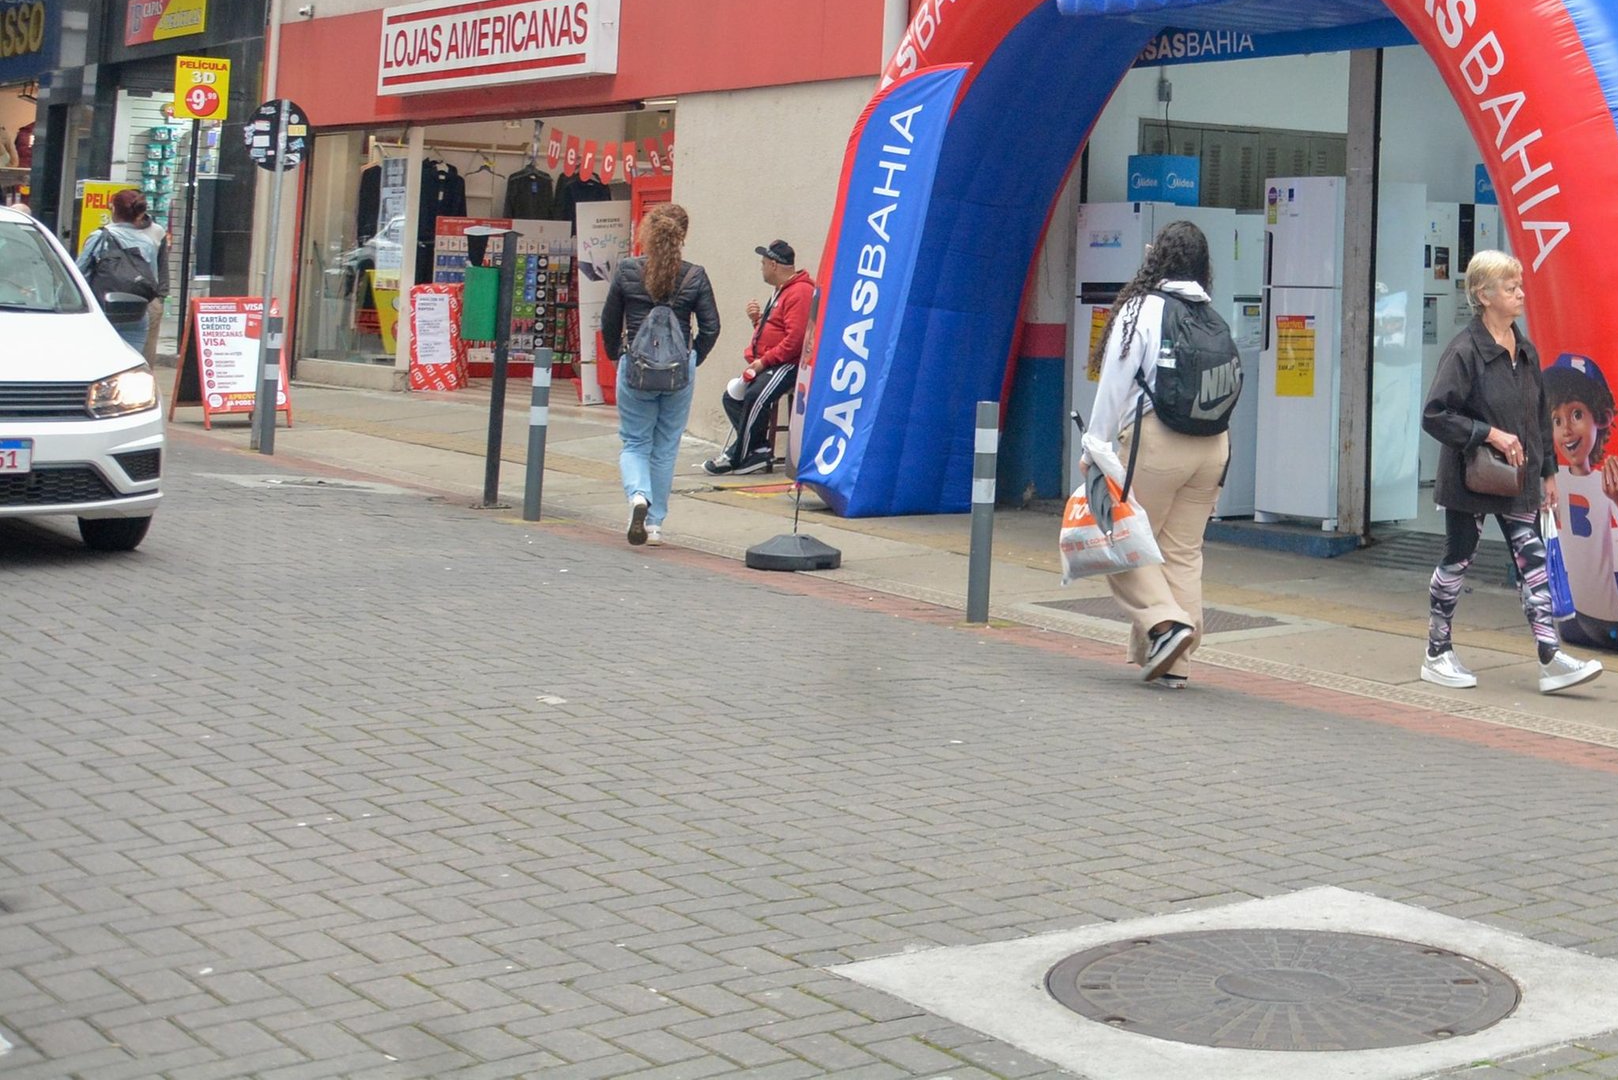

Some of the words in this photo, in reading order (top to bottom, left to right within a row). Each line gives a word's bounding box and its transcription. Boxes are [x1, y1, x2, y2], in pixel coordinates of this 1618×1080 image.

[383, 24, 442, 69] LOJAS
[445, 2, 588, 62] AMERICANAS
[179, 60, 228, 71] PELÍCULA
[192, 71, 216, 84] 3D
[85, 190, 113, 209] PELÍ
[815, 104, 924, 476] CASASBAHIA
[243, 303, 264, 311] VISA
[203, 338, 226, 346] VISA
[1200, 356, 1241, 404] NIK
